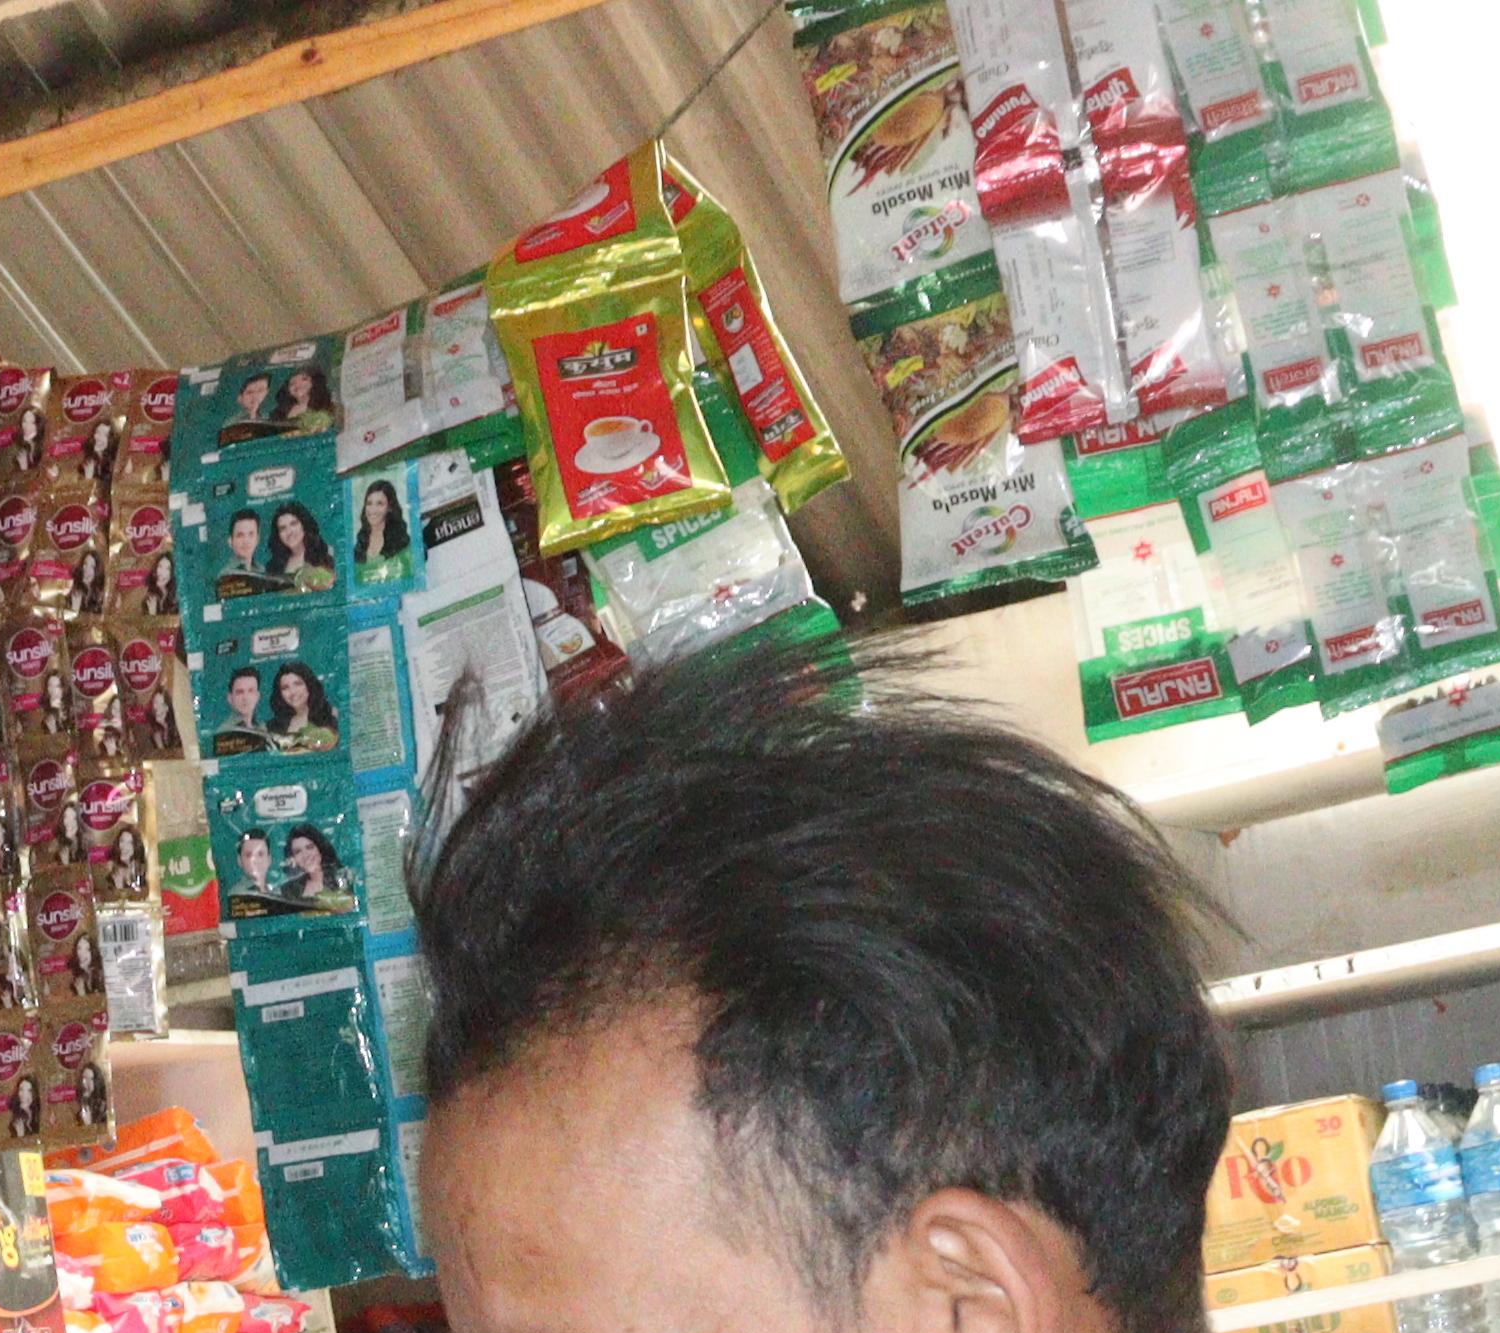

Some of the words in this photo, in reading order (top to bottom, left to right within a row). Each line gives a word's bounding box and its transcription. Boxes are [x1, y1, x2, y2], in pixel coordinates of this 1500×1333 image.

[973, 89, 1031, 139] Purnima
[937, 170, 972, 194] Mix
[870, 183, 935, 219] Masala
[139, 391, 175, 407] suns
[1017, 363, 1081, 410] Purnima
[63, 390, 114, 409] sunsilk
[1001, 472, 1037, 497] Mix
[931, 482, 998, 516] Masala
[1210, 483, 1264, 516] ANJALI
[45, 517, 98, 536] sunsilk
[125, 520, 170, 539] sunsilk
[1428, 606, 1482, 632] ANJAL
[1117, 616, 1193, 651] SPICES
[5, 641, 55, 664] sunsilk
[119, 650, 162, 674] sunsilk
[1120, 671, 1213, 712] ANJALI
[27, 769, 74, 795] sunsilk
[36, 905, 84, 928] sunsilk
[1315, 1115, 1343, 1134] 30
